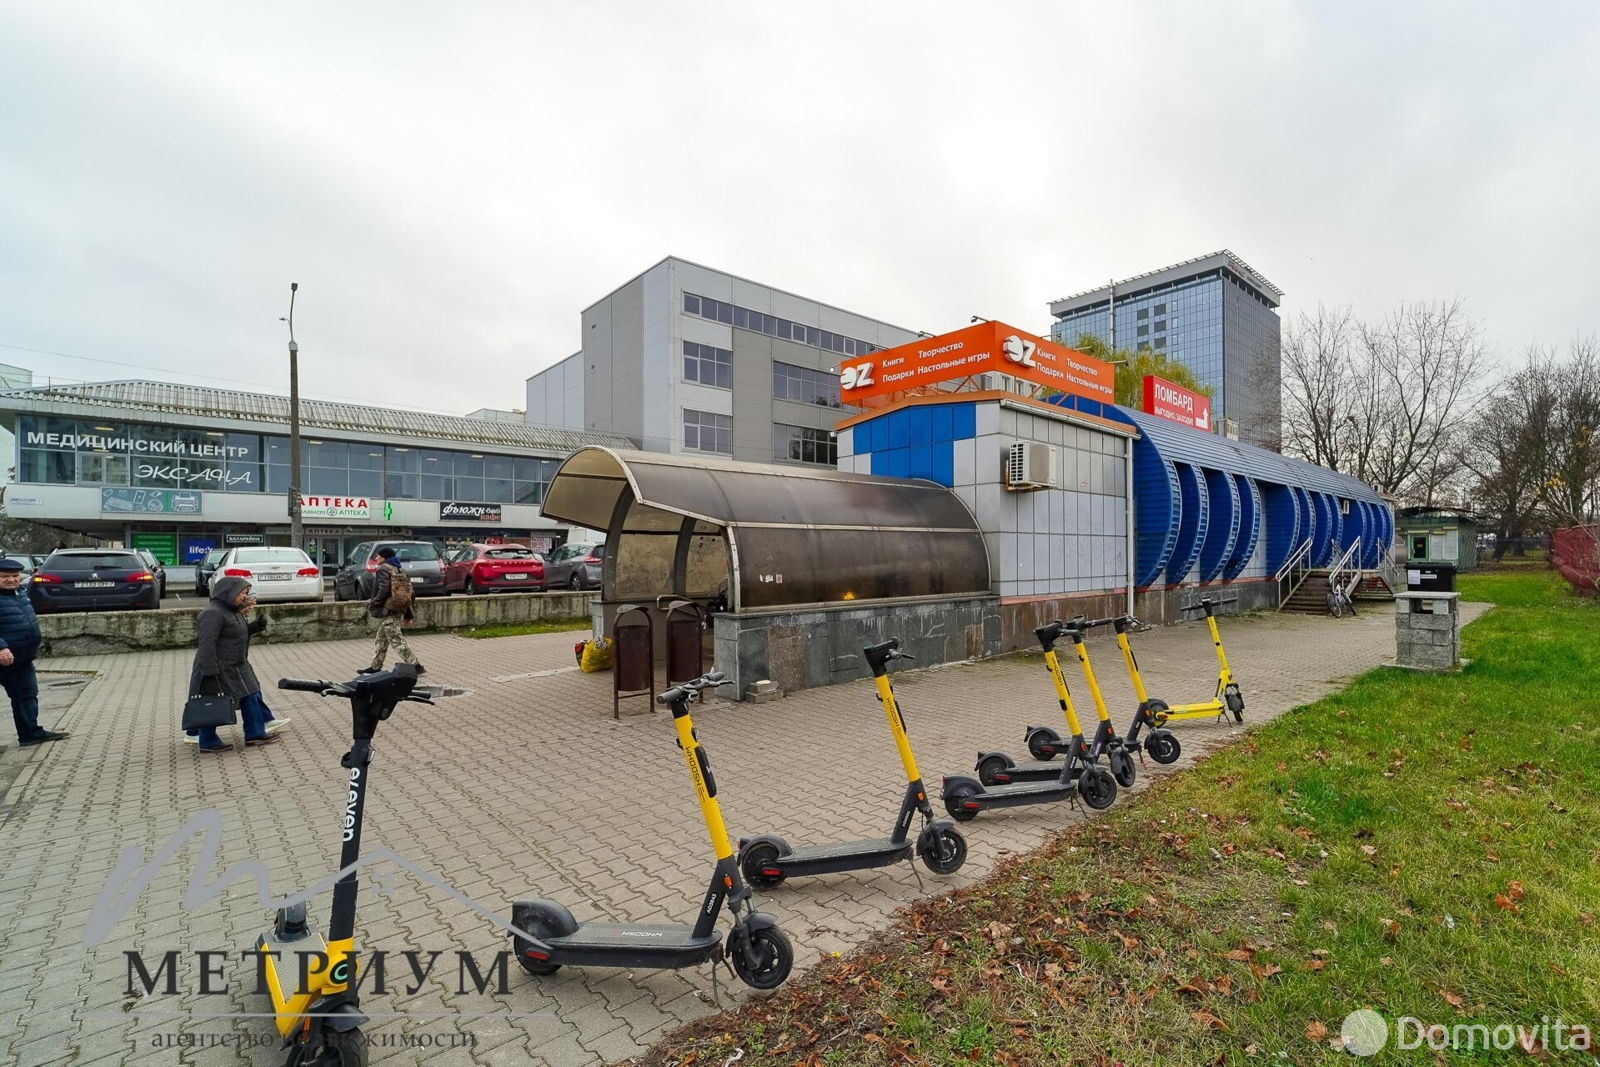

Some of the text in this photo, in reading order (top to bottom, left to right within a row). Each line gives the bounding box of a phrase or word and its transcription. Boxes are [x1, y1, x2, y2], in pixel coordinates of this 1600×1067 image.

[882, 342, 964, 368] Книги Творчество
[882, 351, 990, 383] Подарки Настольные игры
[1037, 347, 1098, 376] Книги Творчество
[1037, 362, 1113, 395] Подарки Настольные игры
[1155, 383, 1194, 414] ЛОМБАРД
[27, 431, 249, 458] МЕДИЦИНСКИЙ ЦЕНТР
[685, 745, 702, 786] WHOOSH
